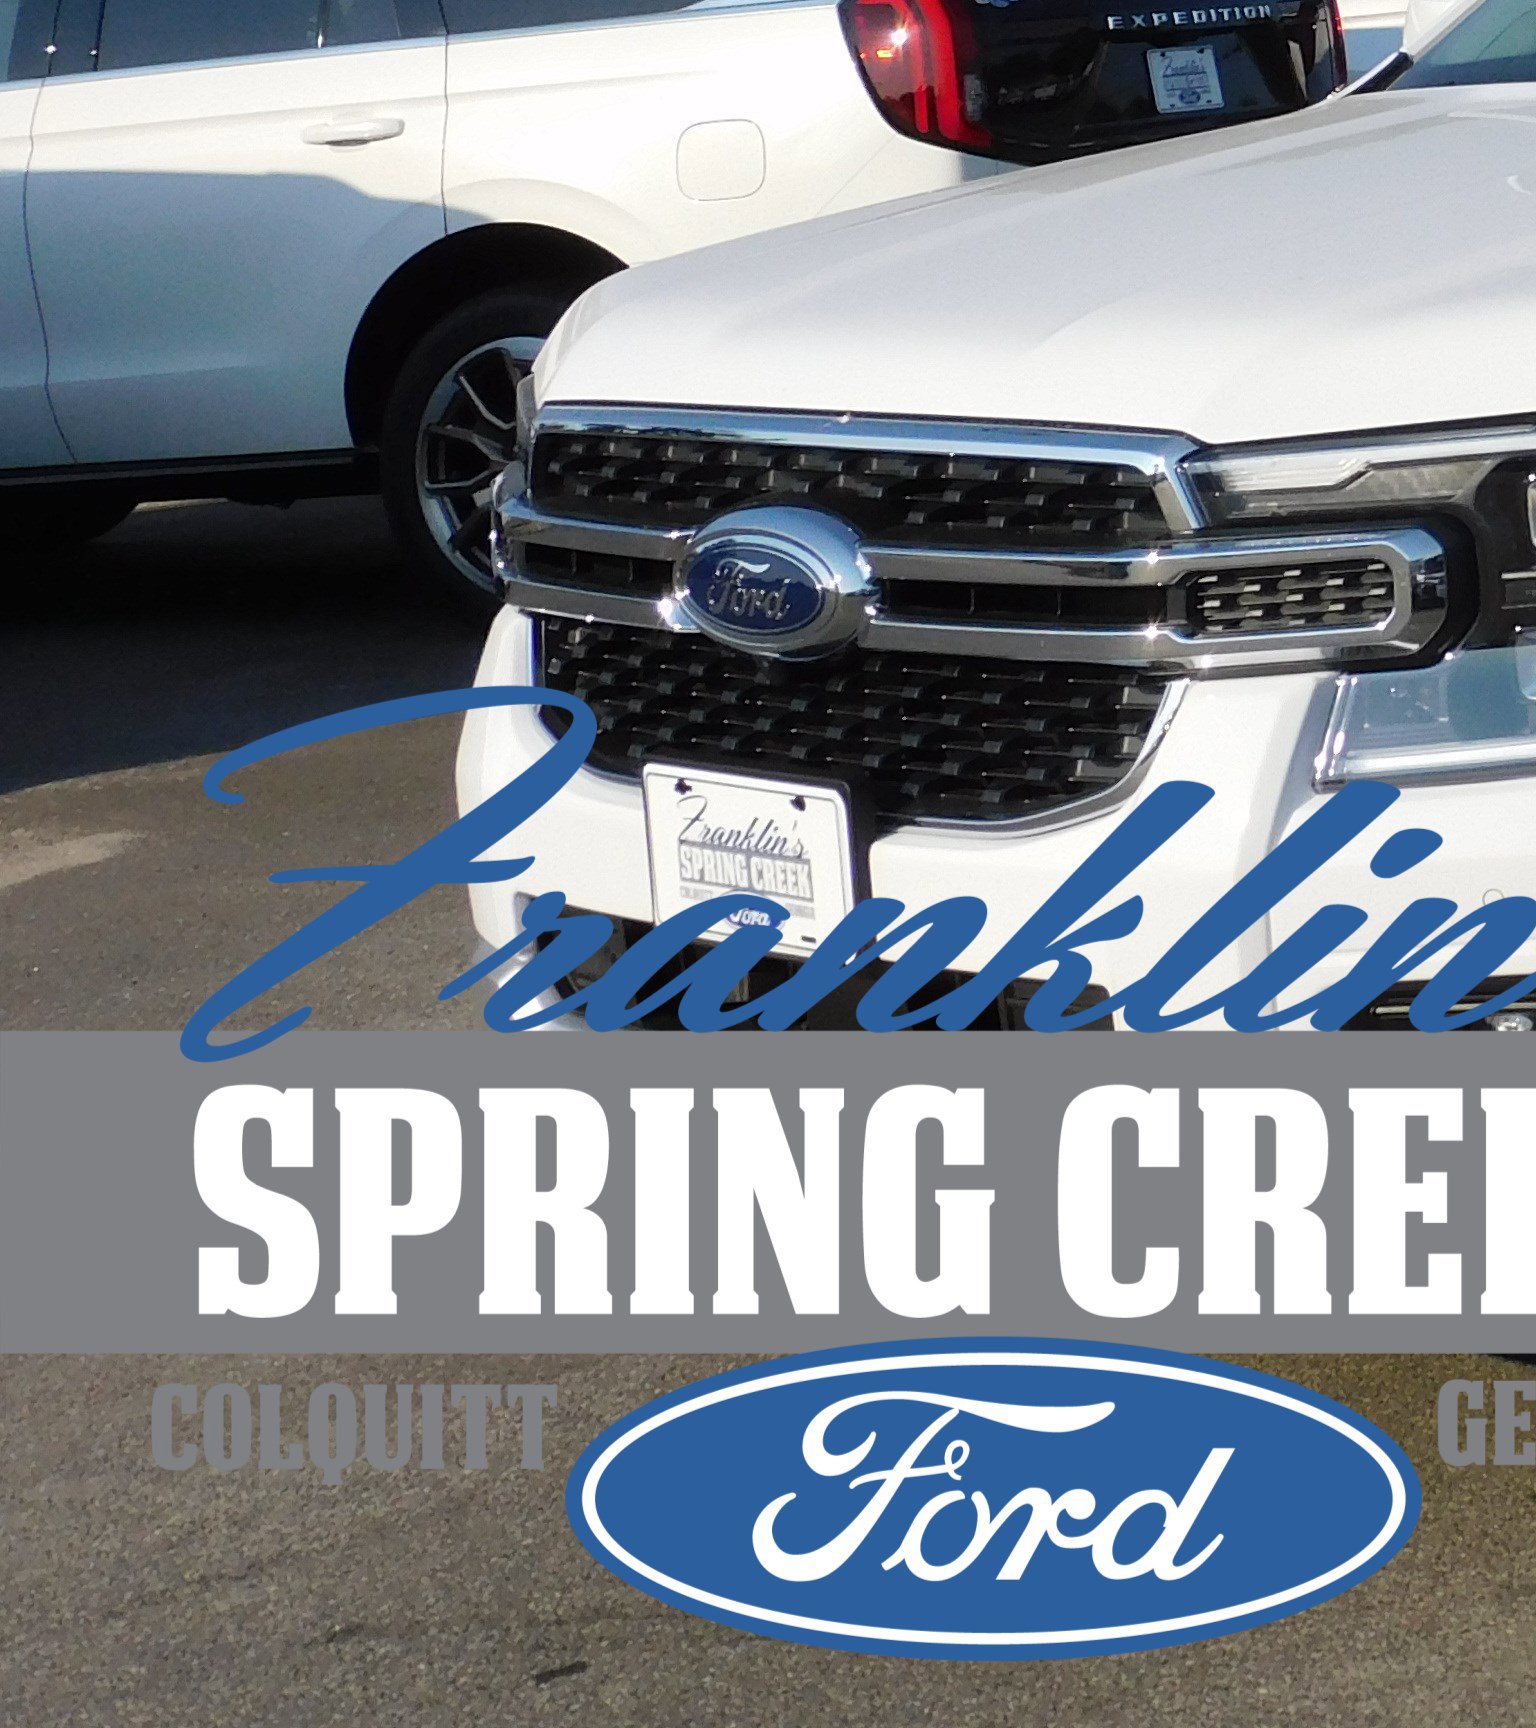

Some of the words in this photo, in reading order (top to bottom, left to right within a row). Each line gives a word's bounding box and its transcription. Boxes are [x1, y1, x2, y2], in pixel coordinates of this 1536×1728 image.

[1107, 4, 1271, 30] EXPEDITION
[707, 558, 791, 620] Ford
[676, 795, 809, 858] Franklin's
[680, 844, 748, 888] SPRING
[751, 855, 813, 899] CREEK
